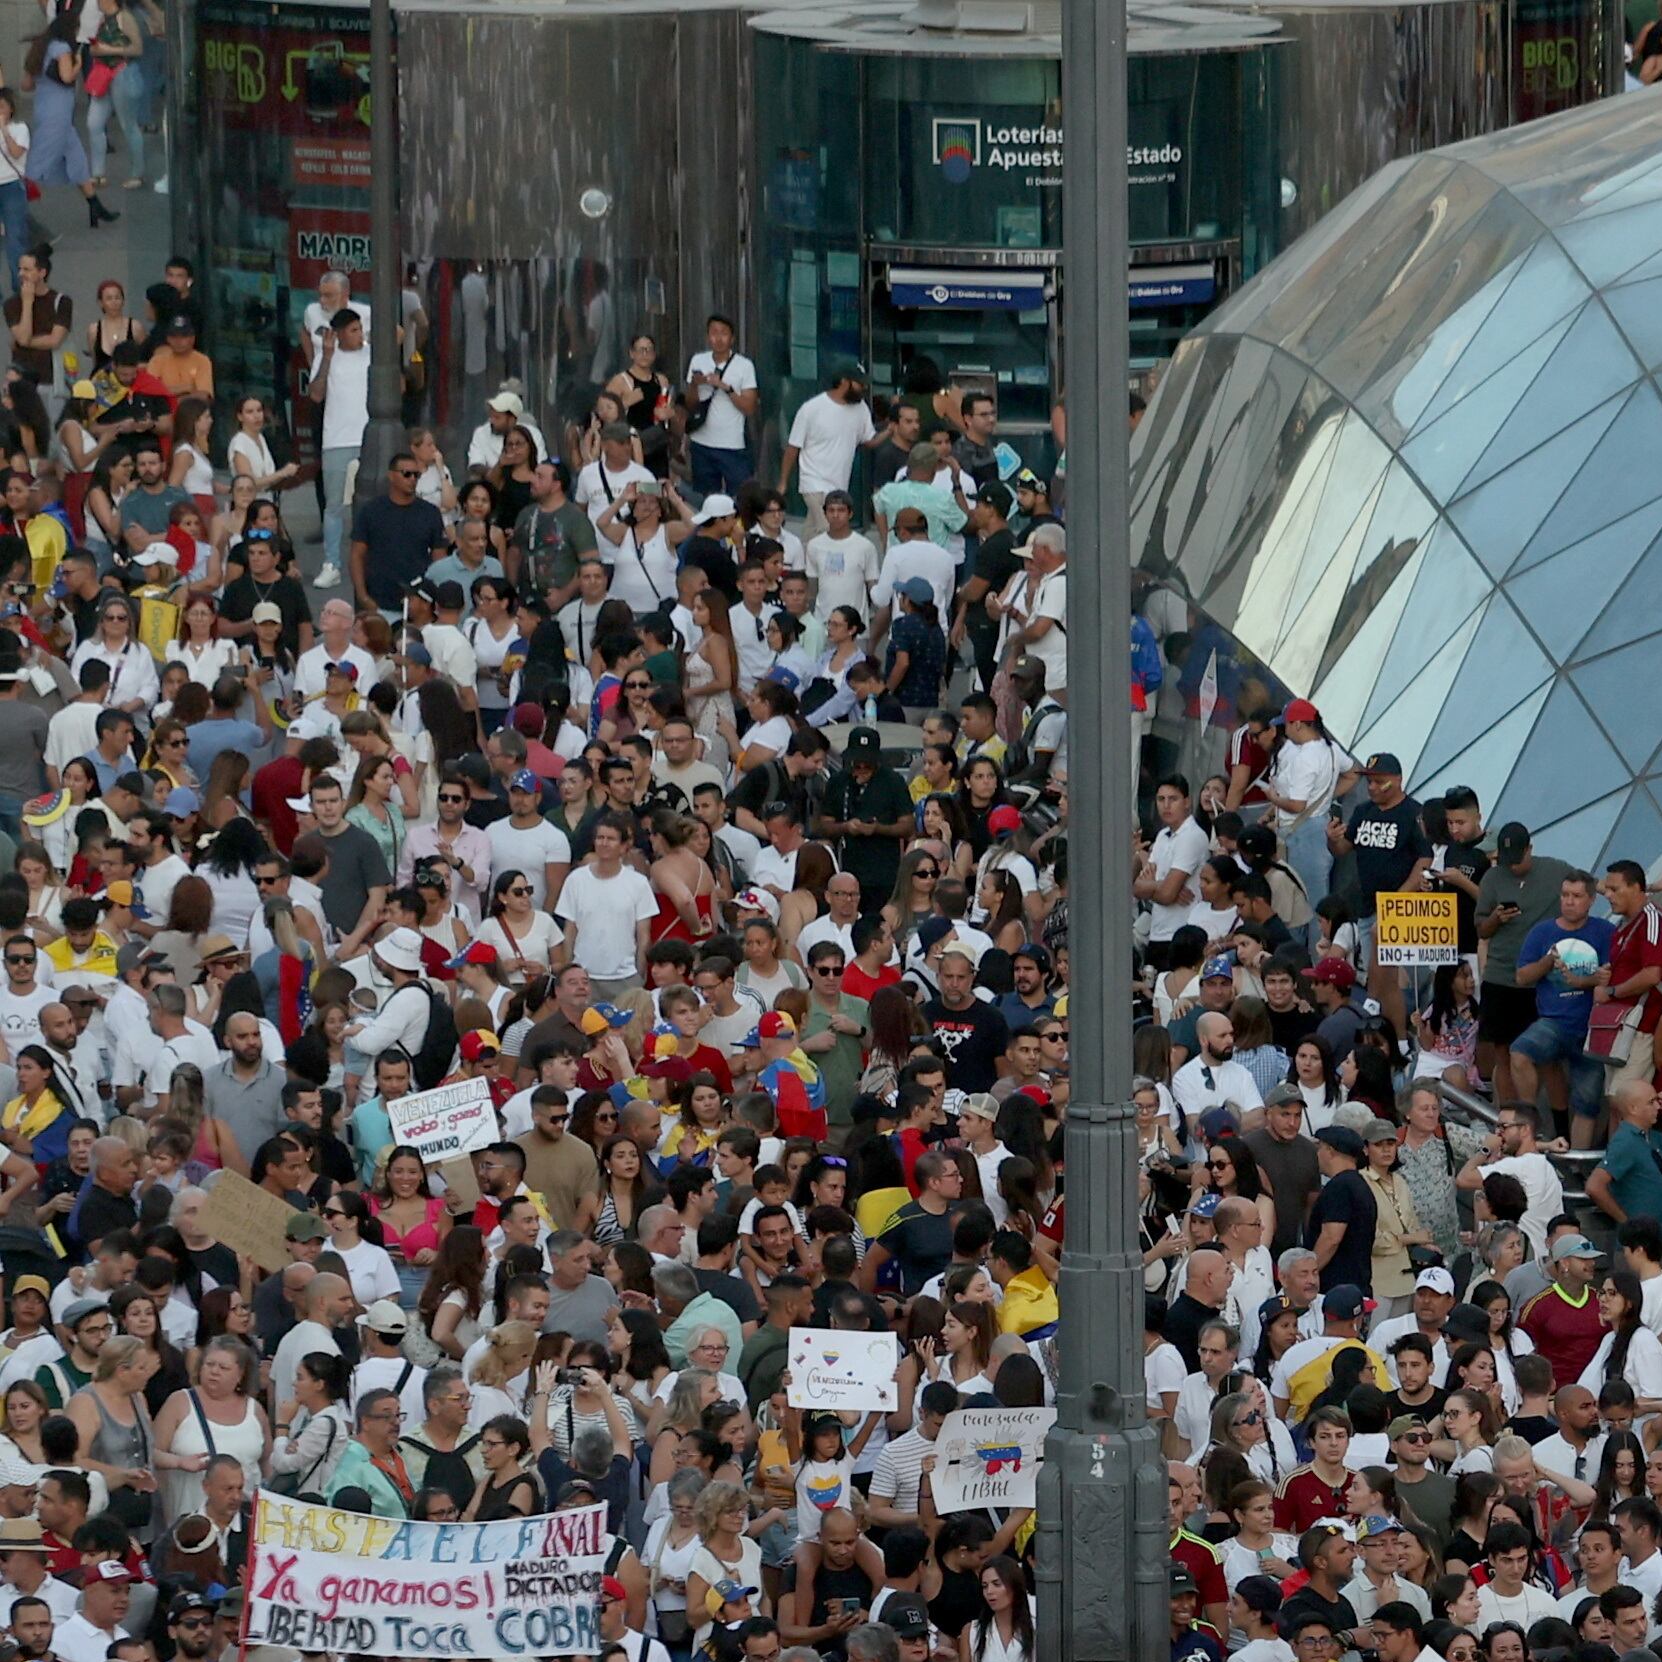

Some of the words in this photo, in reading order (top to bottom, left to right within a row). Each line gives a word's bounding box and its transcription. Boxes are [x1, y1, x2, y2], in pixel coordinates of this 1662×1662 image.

[205, 40, 237, 71] BIG
[1522, 40, 1556, 69] BIG
[1353, 833, 1396, 850] JONES
[1381, 899, 1451, 922] ¡PEDIMOS
[1379, 926, 1399, 945] LO
[1402, 926, 1455, 946] JUSTO!
[391, 1080, 489, 1126] VENEZUELA
[420, 1136, 459, 1156] MUNDO
[256, 1499, 413, 1561] HASTA
[432, 1523, 499, 1565] EL
[504, 1560, 569, 1576] MADURO
[258, 1554, 301, 1604] Ya
[320, 1570, 496, 1622] ganamos!
